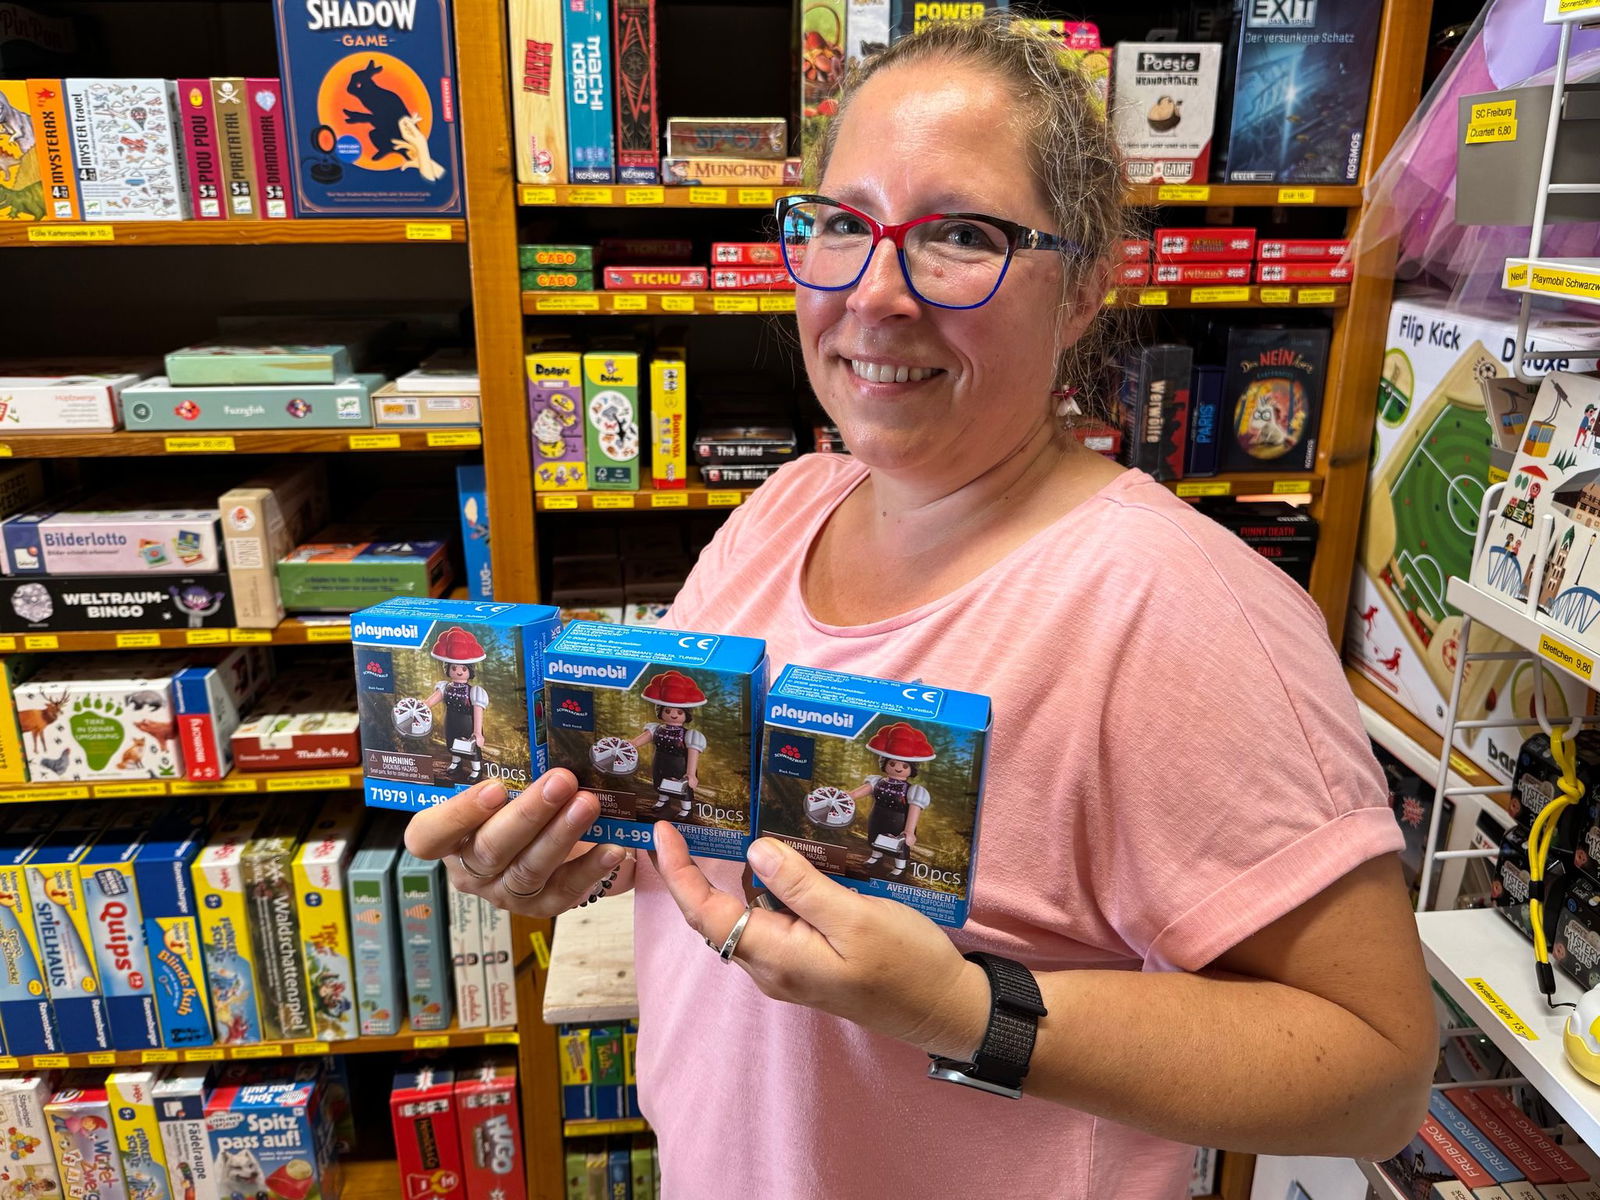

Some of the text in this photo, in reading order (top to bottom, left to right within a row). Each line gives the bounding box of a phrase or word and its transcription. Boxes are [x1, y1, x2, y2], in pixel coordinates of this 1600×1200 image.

[306, 0, 416, 31] SHADOW
[914, 3, 986, 20] POWER
[1252, 0, 1315, 23] EXIT
[341, 35, 389, 47] GAME
[1263, 33, 1320, 44] versunkene
[1322, 32, 1355, 44] Schatz
[523, 39, 553, 96] BANG!
[1143, 54, 1196, 72] Poesie
[71, 93, 84, 123] travel
[1475, 110, 1485, 119] SC
[191, 115, 214, 182] PIOU PIOU
[1346, 132, 1361, 180] KOSMOS
[575, 172, 610, 180] KOSMOS
[621, 169, 655, 179] KOSMOS
[536, 252, 576, 265] CABO
[537, 273, 577, 287] CABO
[632, 273, 681, 285] TICHU
[1532, 273, 1563, 287] Playmobil
[1399, 313, 1461, 350] Flip Kick
[1501, 337, 1570, 372] Dluxe
[1196, 404, 1216, 444] PARIS
[717, 446, 763, 457] The Mind
[723, 470, 768, 481] The Mind
[44, 532, 127, 548] Bilderlotto
[1240, 527, 1296, 537] FUNNY DEATH
[62, 591, 170, 606] WELTRAUM-
[87, 605, 144, 619] BINGO
[354, 621, 418, 640] playmobil
[1542, 640, 1592, 675] Brettchen 9,80
[548, 660, 627, 681] playmobil
[771, 703, 854, 729] playmobil
[381, 754, 416, 766] WARNING:
[370, 786, 408, 804] 71979
[614, 827, 652, 844] 4-99
[886, 883, 958, 905] AVERTISSEMENT:
[36, 902, 67, 988] SPIELHAUS
[100, 901, 132, 971] Quips
[273, 894, 308, 1031] Waldschattenspiel
[177, 986, 197, 1016] Kuh
[1474, 981, 1498, 1005] Mystery
[1495, 1002, 1513, 1020] Light
[38, 1001, 55, 1051] Ravensburger
[247, 1113, 299, 1135] Spitz
[217, 1130, 302, 1151] pass auf!
[1453, 1121, 1509, 1173] FREIBURG
[1485, 1120, 1542, 1172] FREIBURG
[1516, 1119, 1575, 1172] FREIBURG
[1425, 1125, 1480, 1178] FREIBURG
